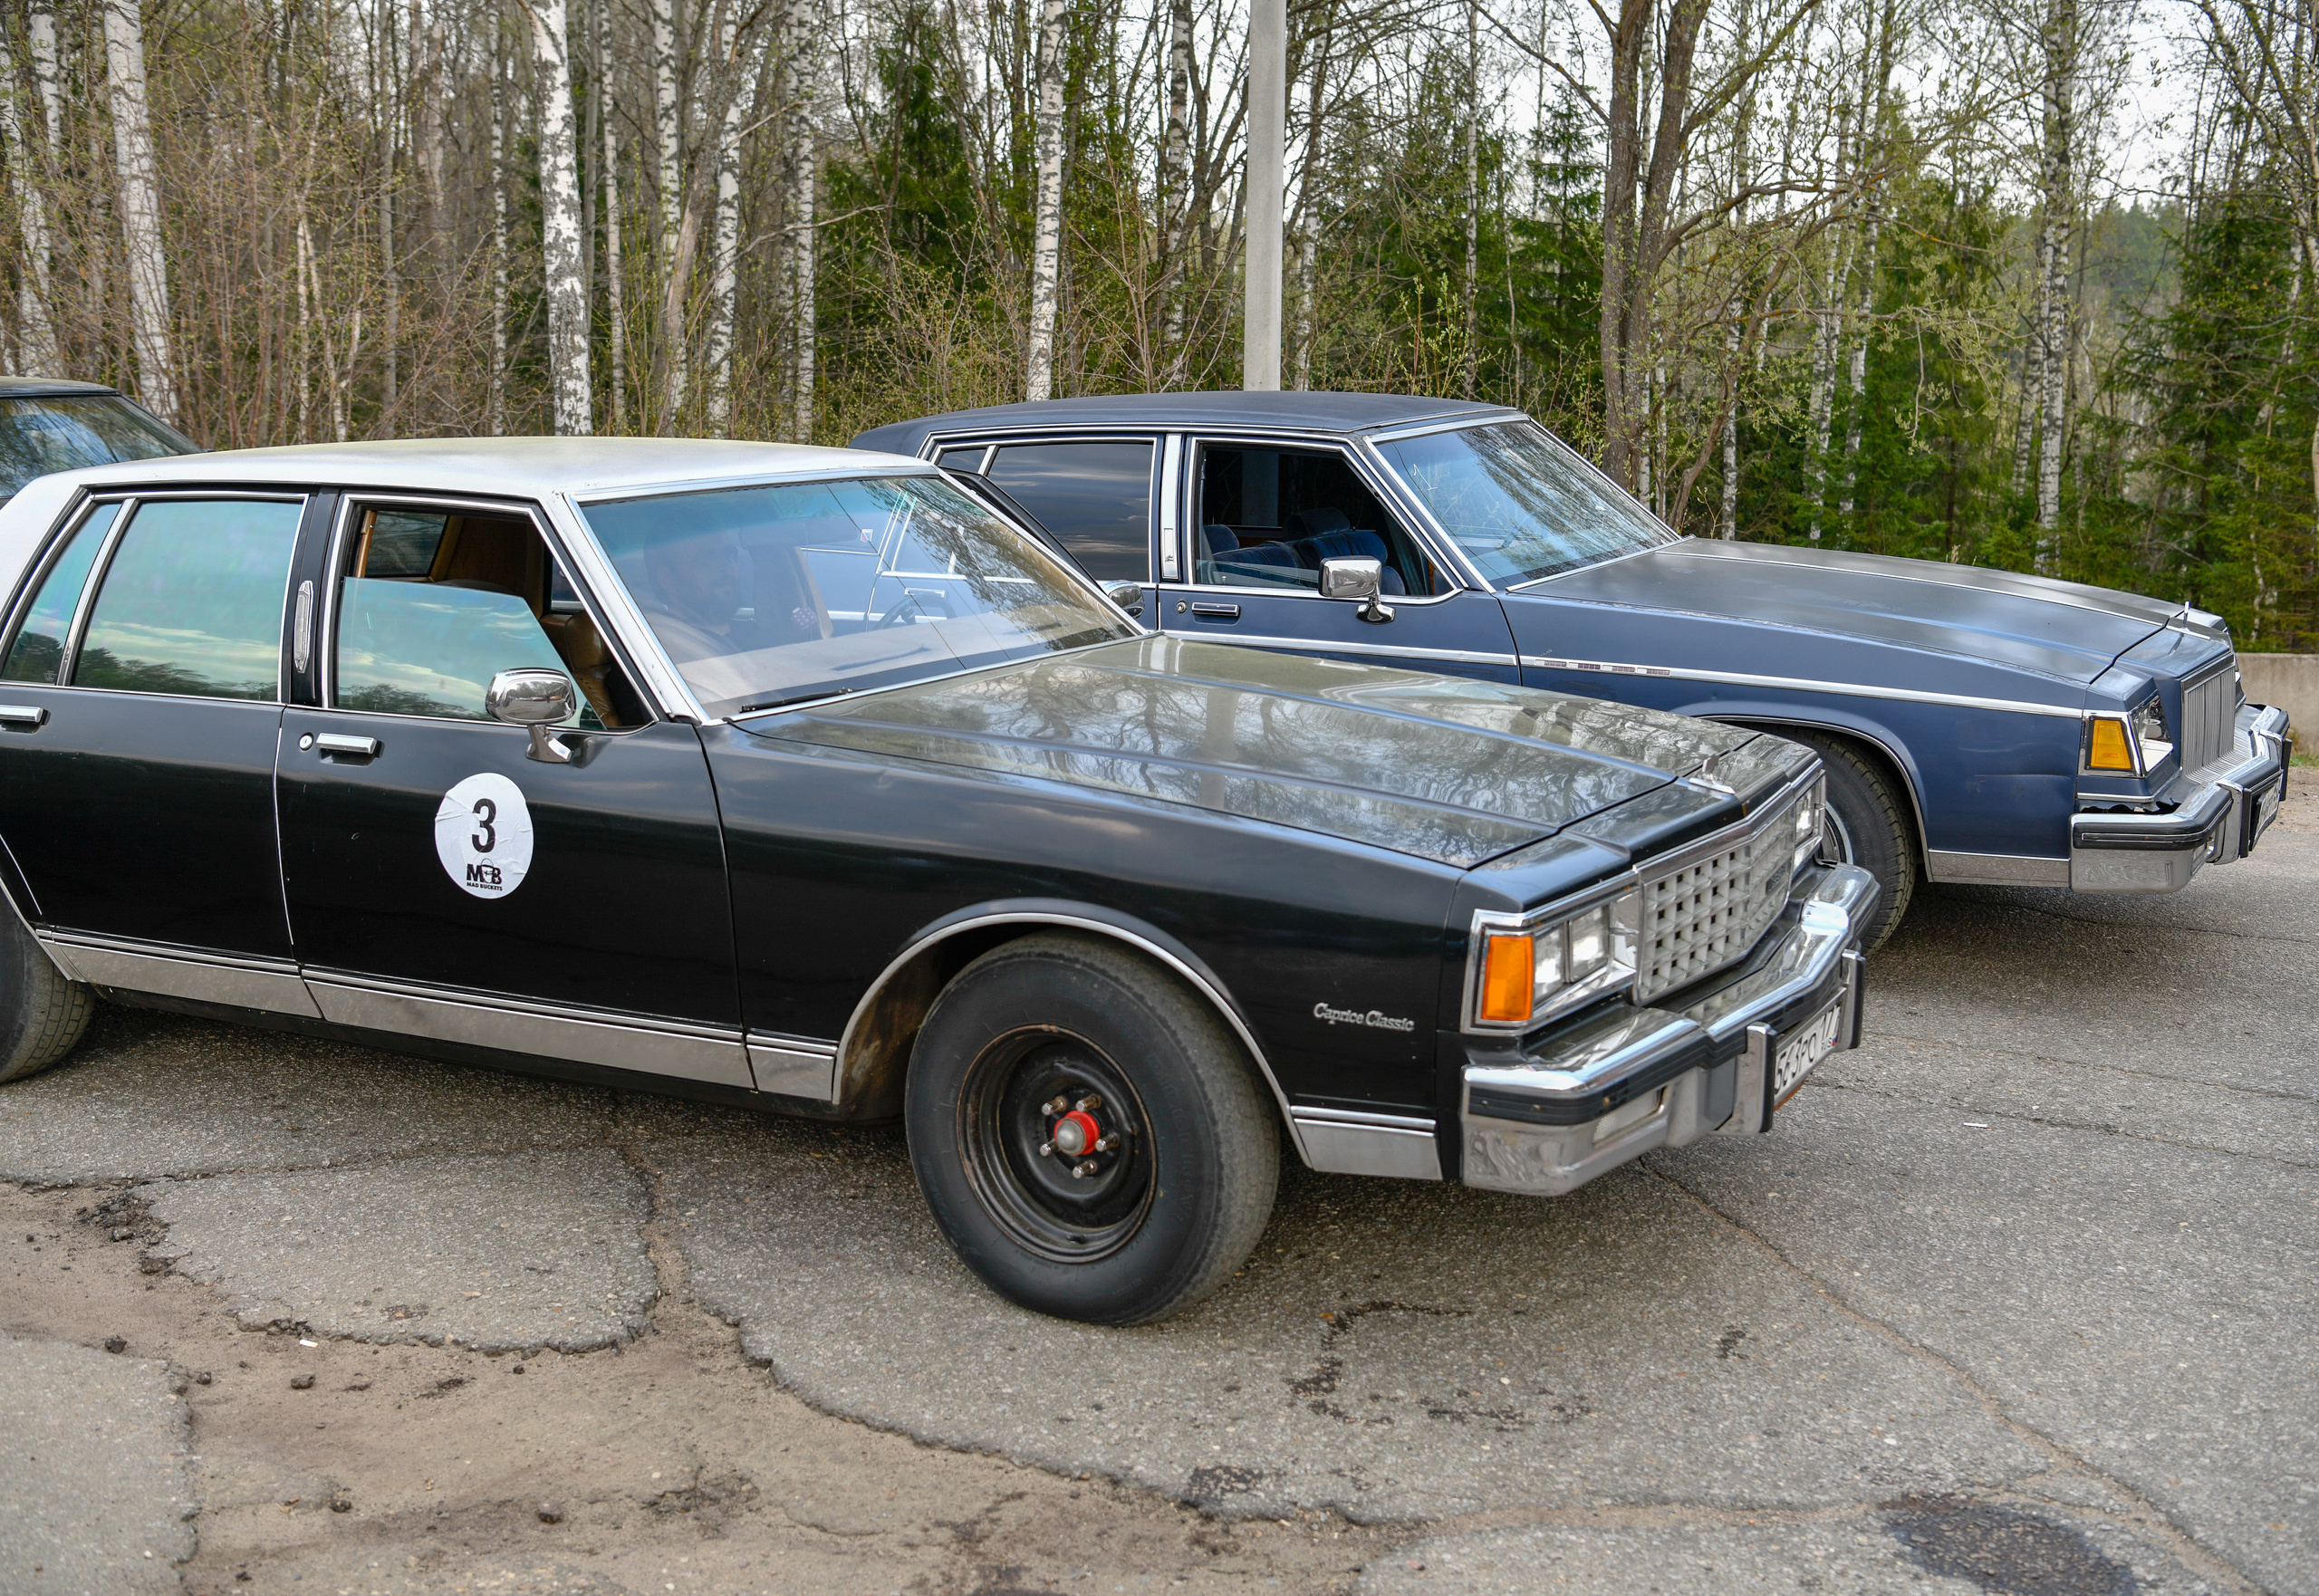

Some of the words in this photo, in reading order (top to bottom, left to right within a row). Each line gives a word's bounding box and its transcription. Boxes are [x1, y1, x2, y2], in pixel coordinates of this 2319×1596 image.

[472, 798, 496, 852] 3
[480, 883, 503, 891] BUCKETS
[1313, 1002, 1364, 1025] Caprice
[1365, 1010, 1415, 1032] Classic
